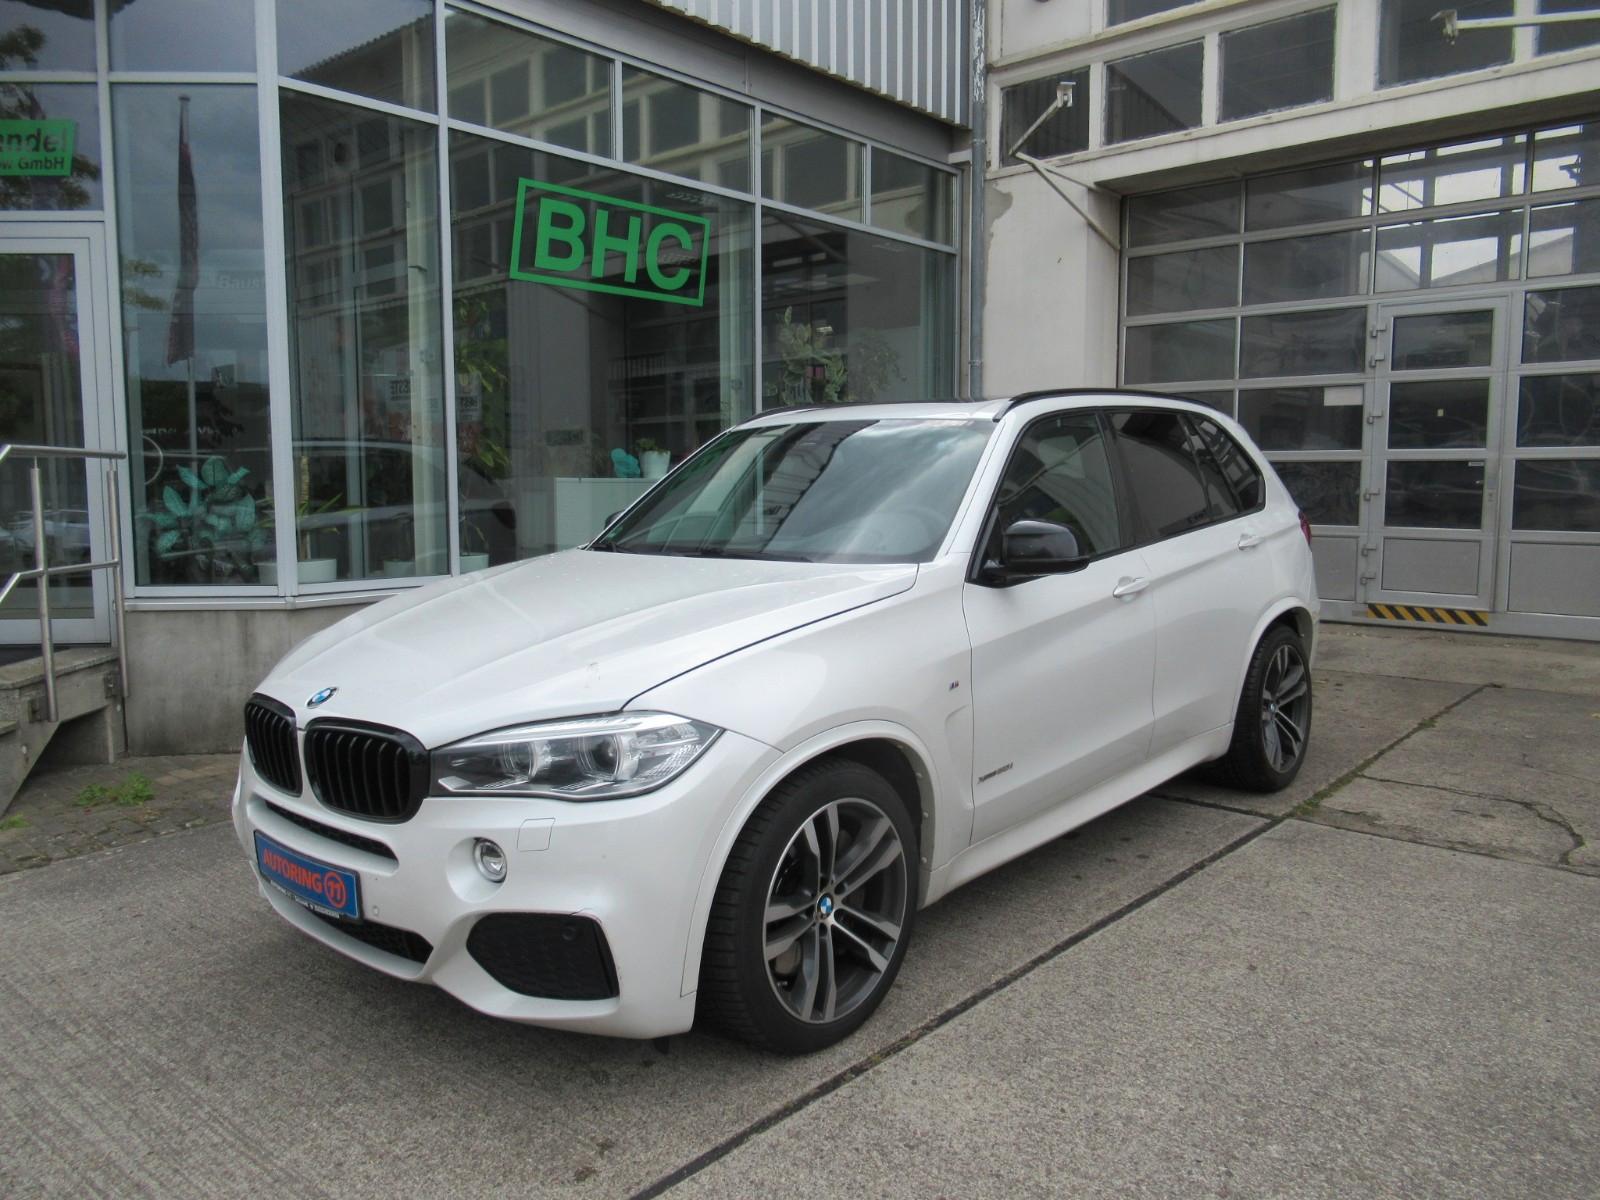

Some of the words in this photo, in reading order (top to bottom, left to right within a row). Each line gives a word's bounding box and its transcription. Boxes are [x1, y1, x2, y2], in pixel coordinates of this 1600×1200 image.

[18, 156, 65, 170] GmbH
[534, 197, 693, 290] BHC
[263, 848, 323, 894] AUTORING
